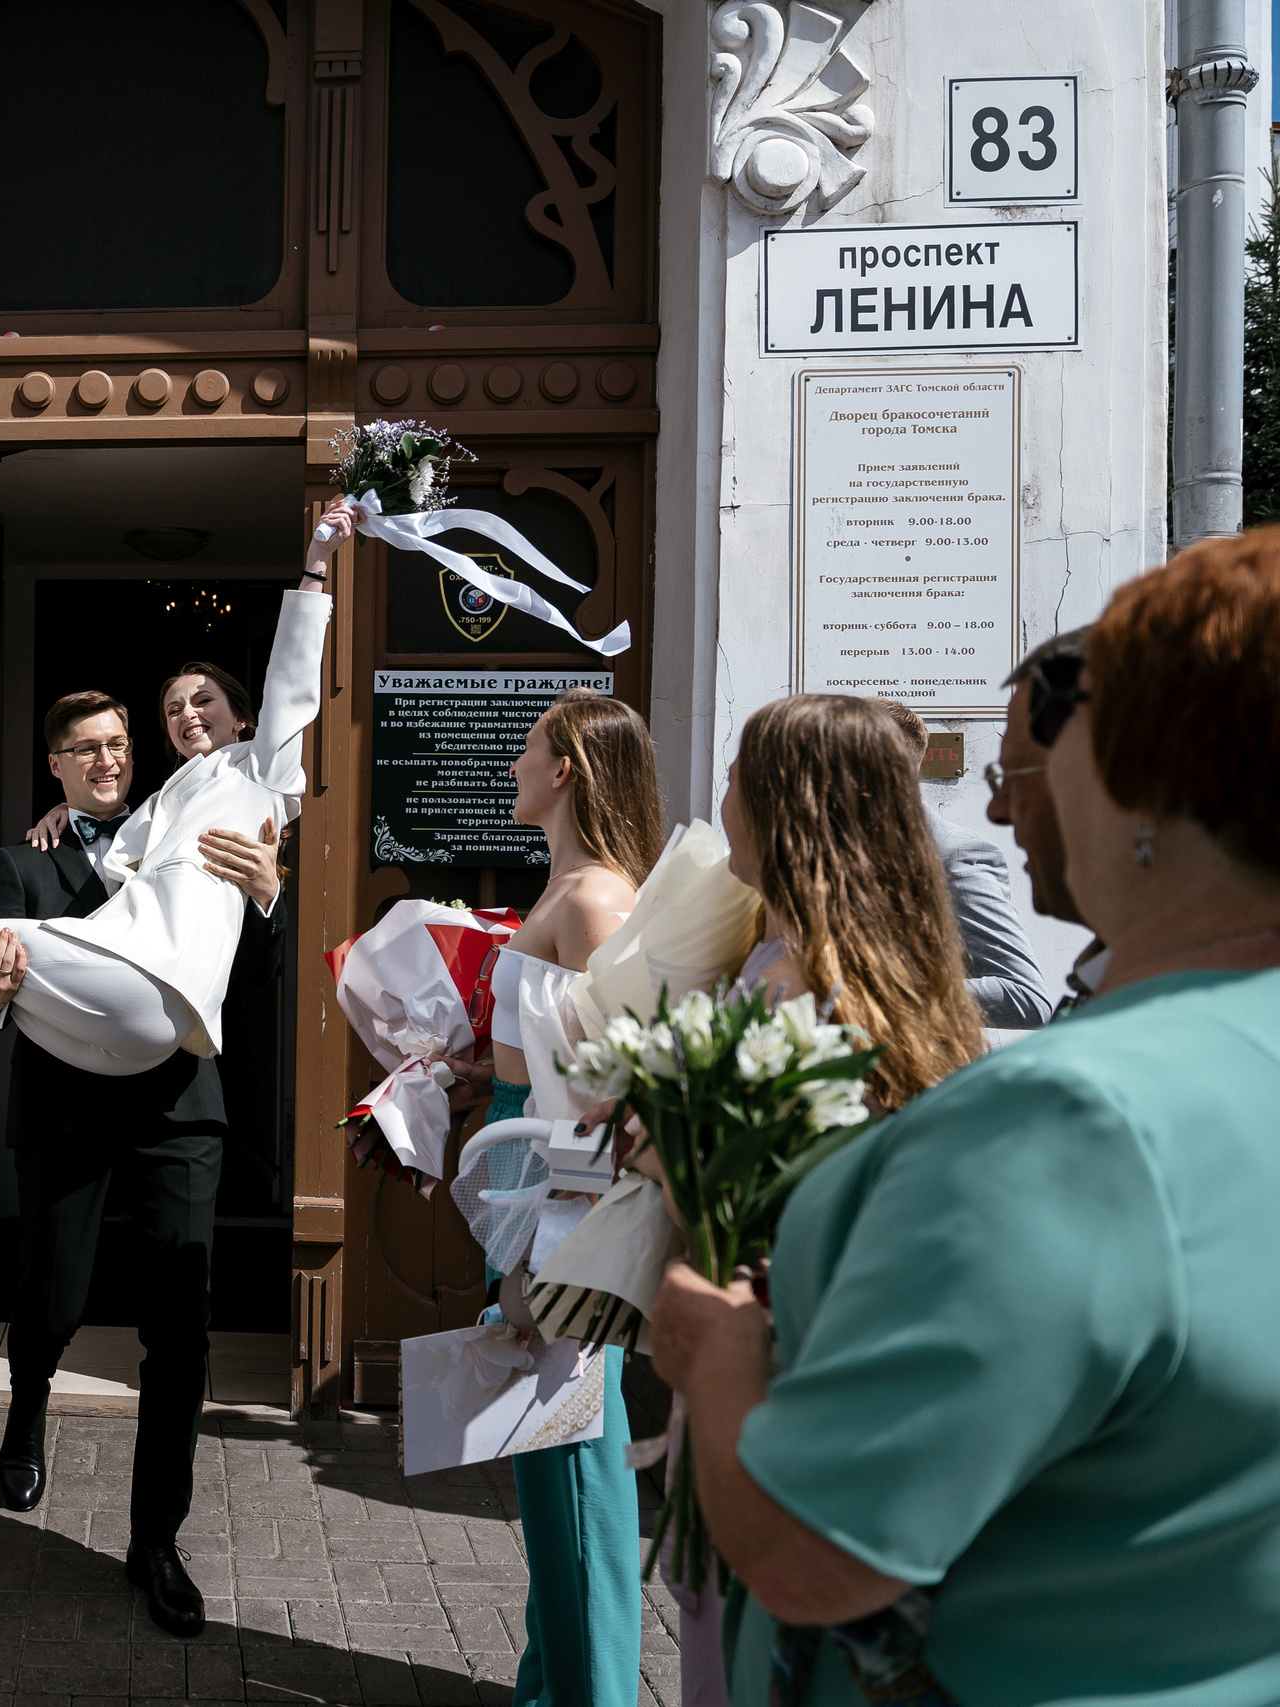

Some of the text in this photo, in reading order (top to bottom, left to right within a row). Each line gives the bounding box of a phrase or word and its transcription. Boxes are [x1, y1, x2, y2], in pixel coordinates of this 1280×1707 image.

[971, 106, 1057, 172] 83
[840, 242, 999, 277] проспект
[810, 284, 1033, 334] ЛЕНИНА
[815, 386, 882, 395] Департамент
[887, 384, 912, 392] ЗАГС
[963, 381, 1004, 391] области
[829, 408, 989, 423] Дворец бракосочетаний
[862, 424, 957, 437] города Томска
[858, 463, 959, 473] Прием заявлений
[867, 479, 968, 489] государственную
[813, 496, 888, 505] регистрацию
[968, 492, 1005, 503] брака.
[847, 516, 971, 528] вторник 9.00-18.00
[827, 540, 859, 548] среда
[872, 539, 917, 548] четверг
[926, 537, 988, 546] 9.00-13.00
[820, 574, 996, 585] Государственная регистрация
[926, 587, 964, 599] брака:
[823, 620, 916, 631] вторник-суббота
[927, 621, 951, 629] 9.00
[966, 620, 994, 628] 18.00
[841, 649, 889, 657] перерыв
[903, 647, 932, 655] 13.00
[946, 647, 975, 655] 14.00
[378, 674, 610, 692] Уважаемые граждане!
[827, 678, 899, 687] воскресенье
[911, 678, 986, 686] понедельник
[395, 697, 415, 707] При
[419, 699, 487, 708] регистрации
[433, 707, 498, 718] соблюдения
[407, 718, 465, 728] избежание
[435, 732, 495, 740] помещения
[435, 740, 525, 752] убедительно про
[441, 757, 516, 767] новобрачных
[432, 778, 487, 788] разбивать
[421, 806, 495, 815] прилегающей
[434, 832, 547, 843] Заранее благодарим
